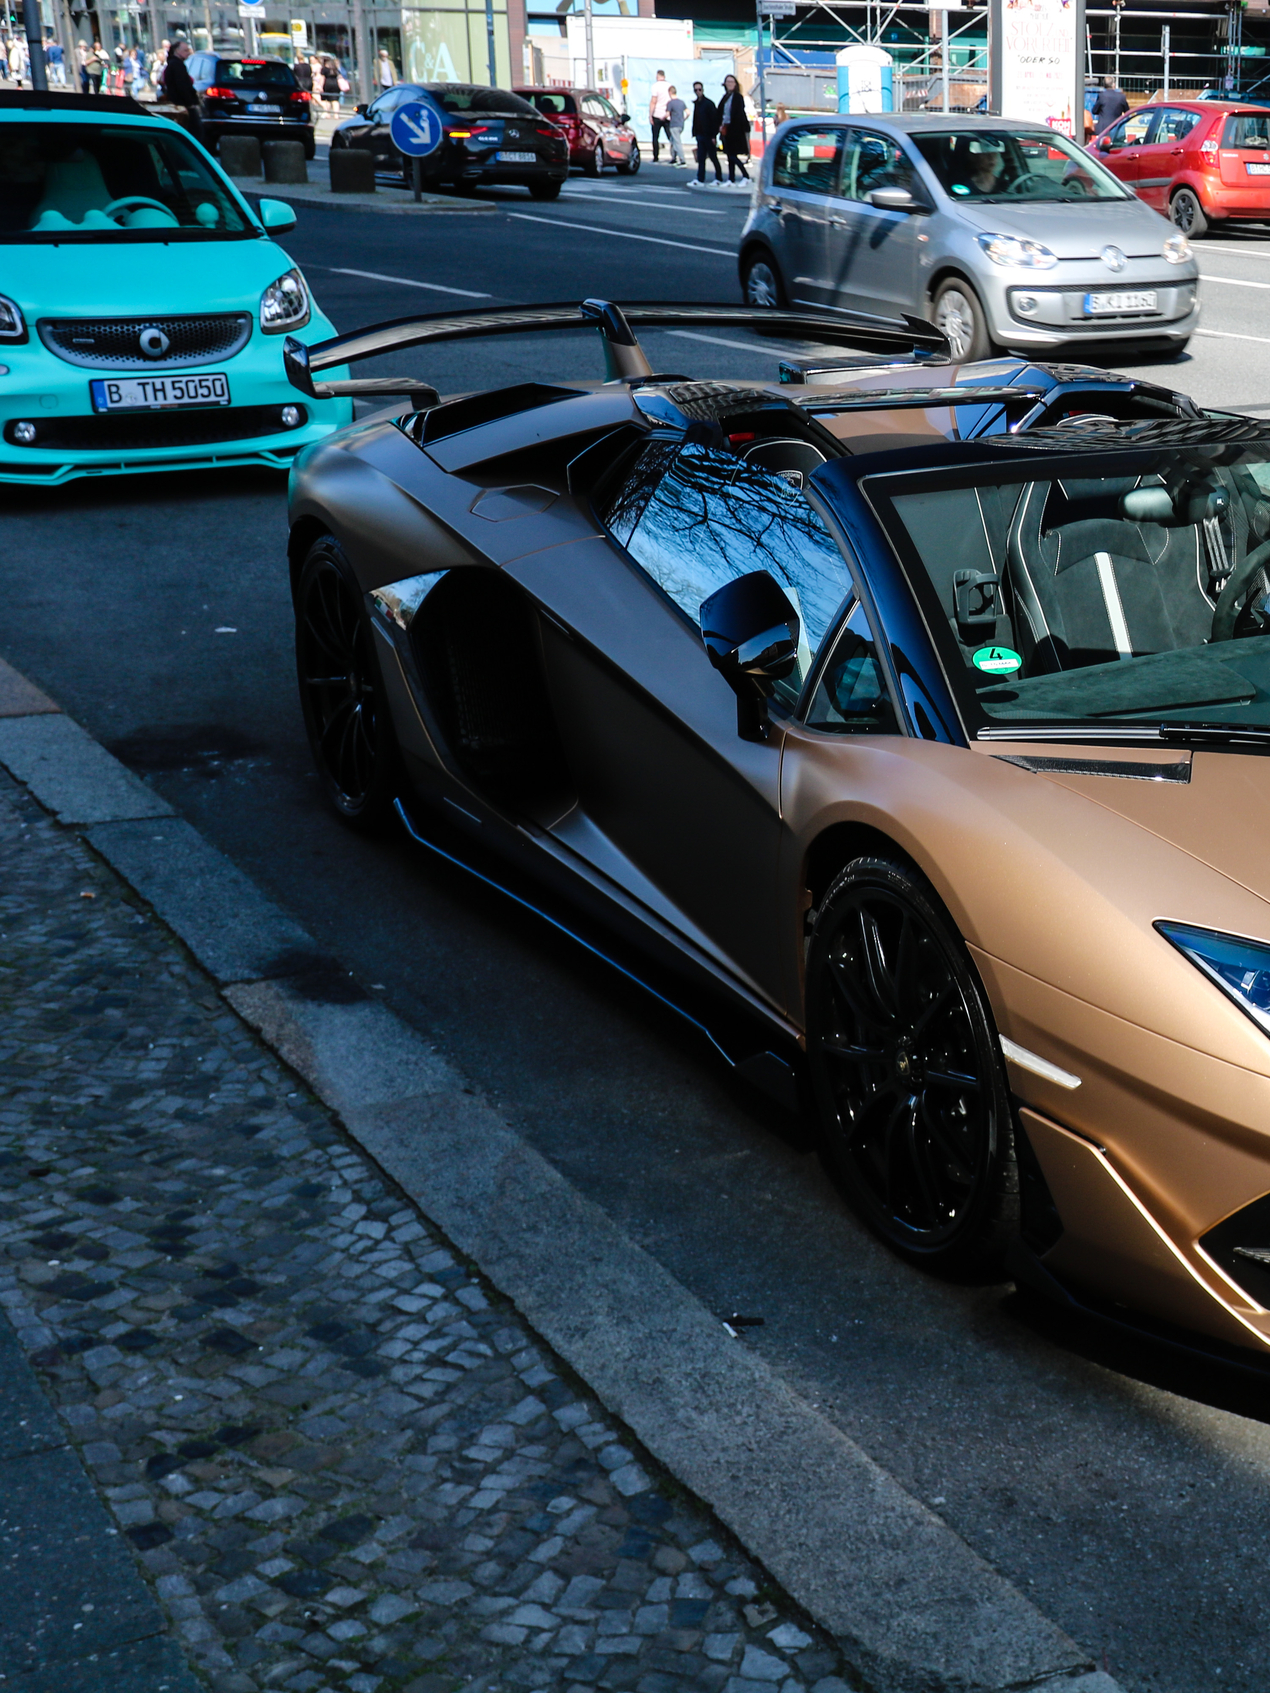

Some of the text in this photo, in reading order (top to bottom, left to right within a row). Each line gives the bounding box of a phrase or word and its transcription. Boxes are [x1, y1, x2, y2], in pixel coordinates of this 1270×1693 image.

[409, 40, 462, 83] C&A
[107, 378, 225, 404] B TH 5050
[989, 648, 1004, 660] 4
